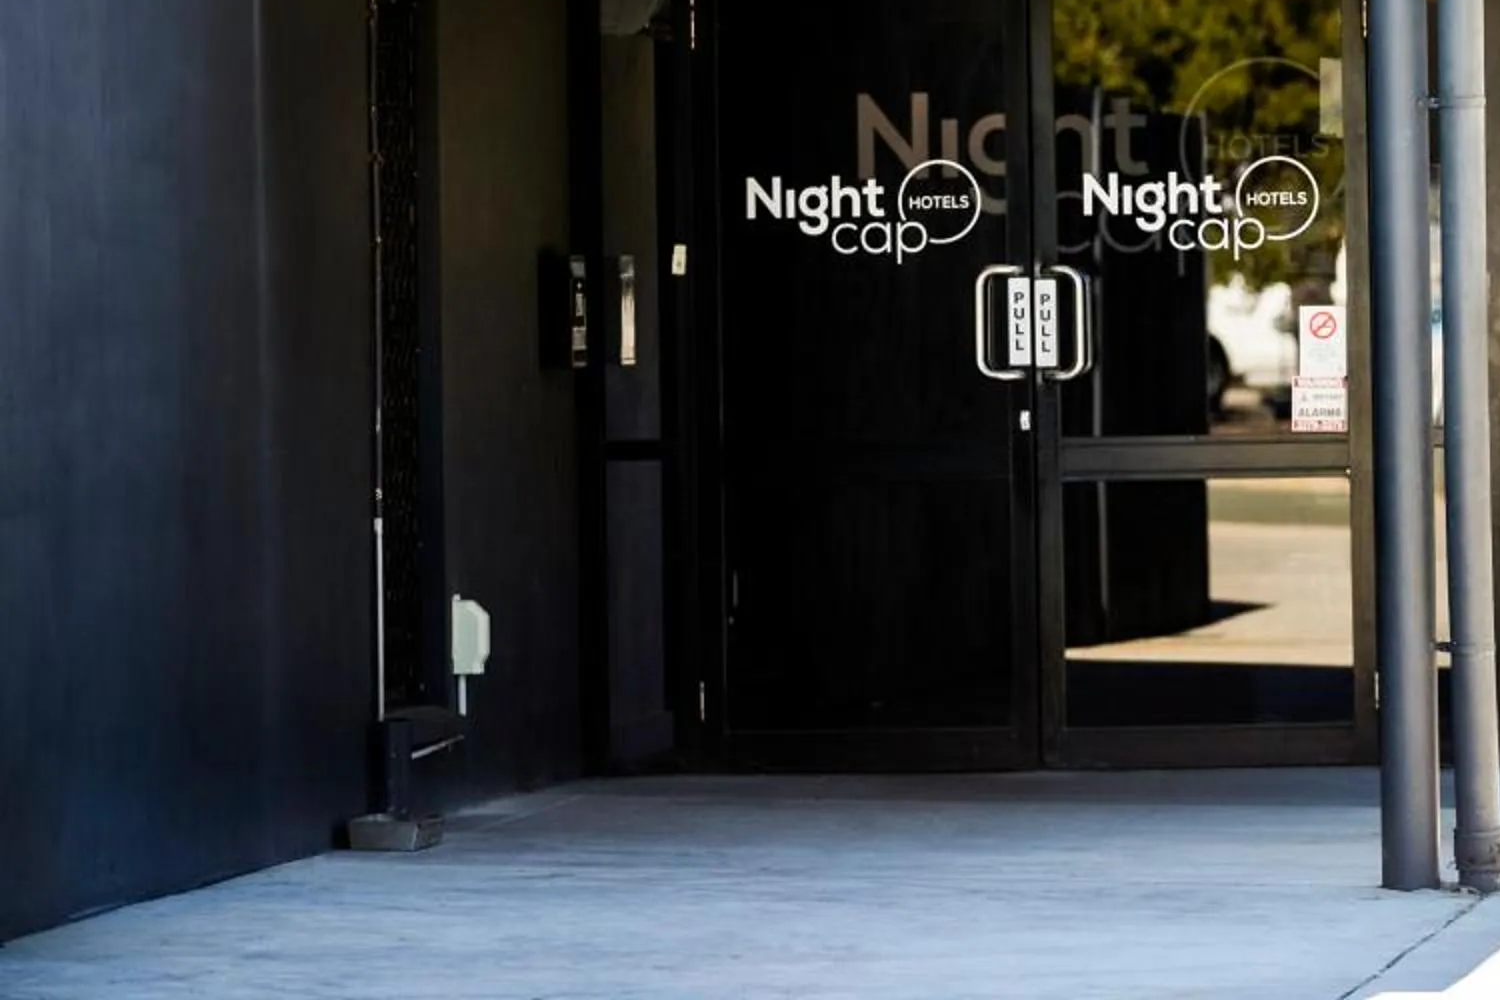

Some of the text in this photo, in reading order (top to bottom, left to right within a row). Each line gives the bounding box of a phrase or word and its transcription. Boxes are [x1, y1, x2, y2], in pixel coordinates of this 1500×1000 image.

[746, 175, 886, 235] Night
[908, 195, 970, 209] HOTELS
[1082, 171, 1223, 232] Night
[1246, 191, 1308, 206] HOTELS
[831, 221, 928, 264] cap
[1168, 217, 1265, 261] cap
[1013, 291, 1025, 351] PULL
[1039, 293, 1051, 353] PULL
